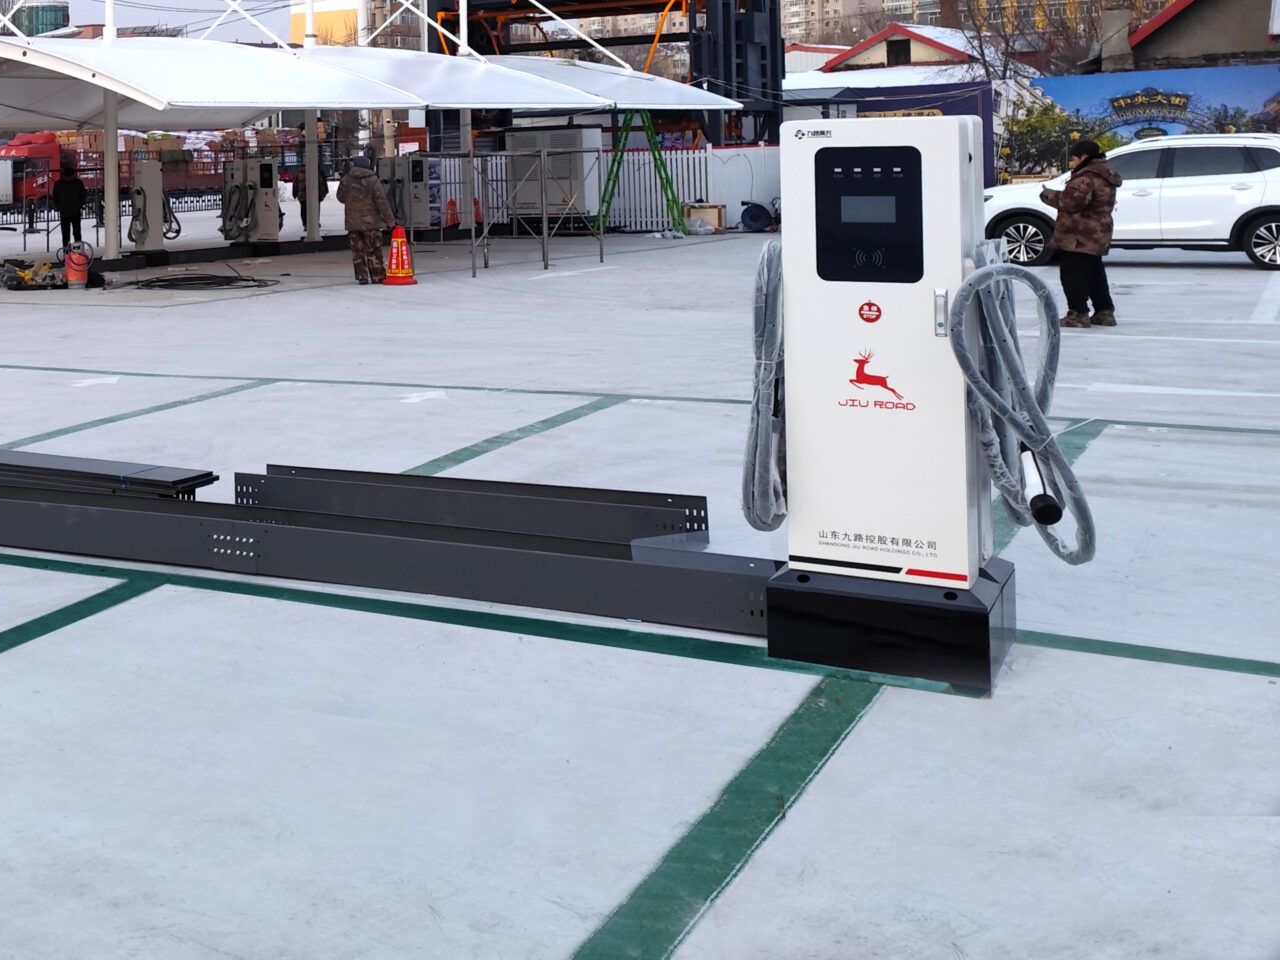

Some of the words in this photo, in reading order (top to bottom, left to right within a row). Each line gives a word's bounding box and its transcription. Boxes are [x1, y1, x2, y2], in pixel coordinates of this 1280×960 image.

[1113, 95, 1187, 107] 中央大街
[838, 398, 869, 408] JIU
[873, 400, 916, 411] ROAD
[818, 529, 937, 551] 山东九路控股有限公司
[818, 540, 851, 549] SHANDONG
[879, 547, 911, 555] HOLDINGS
